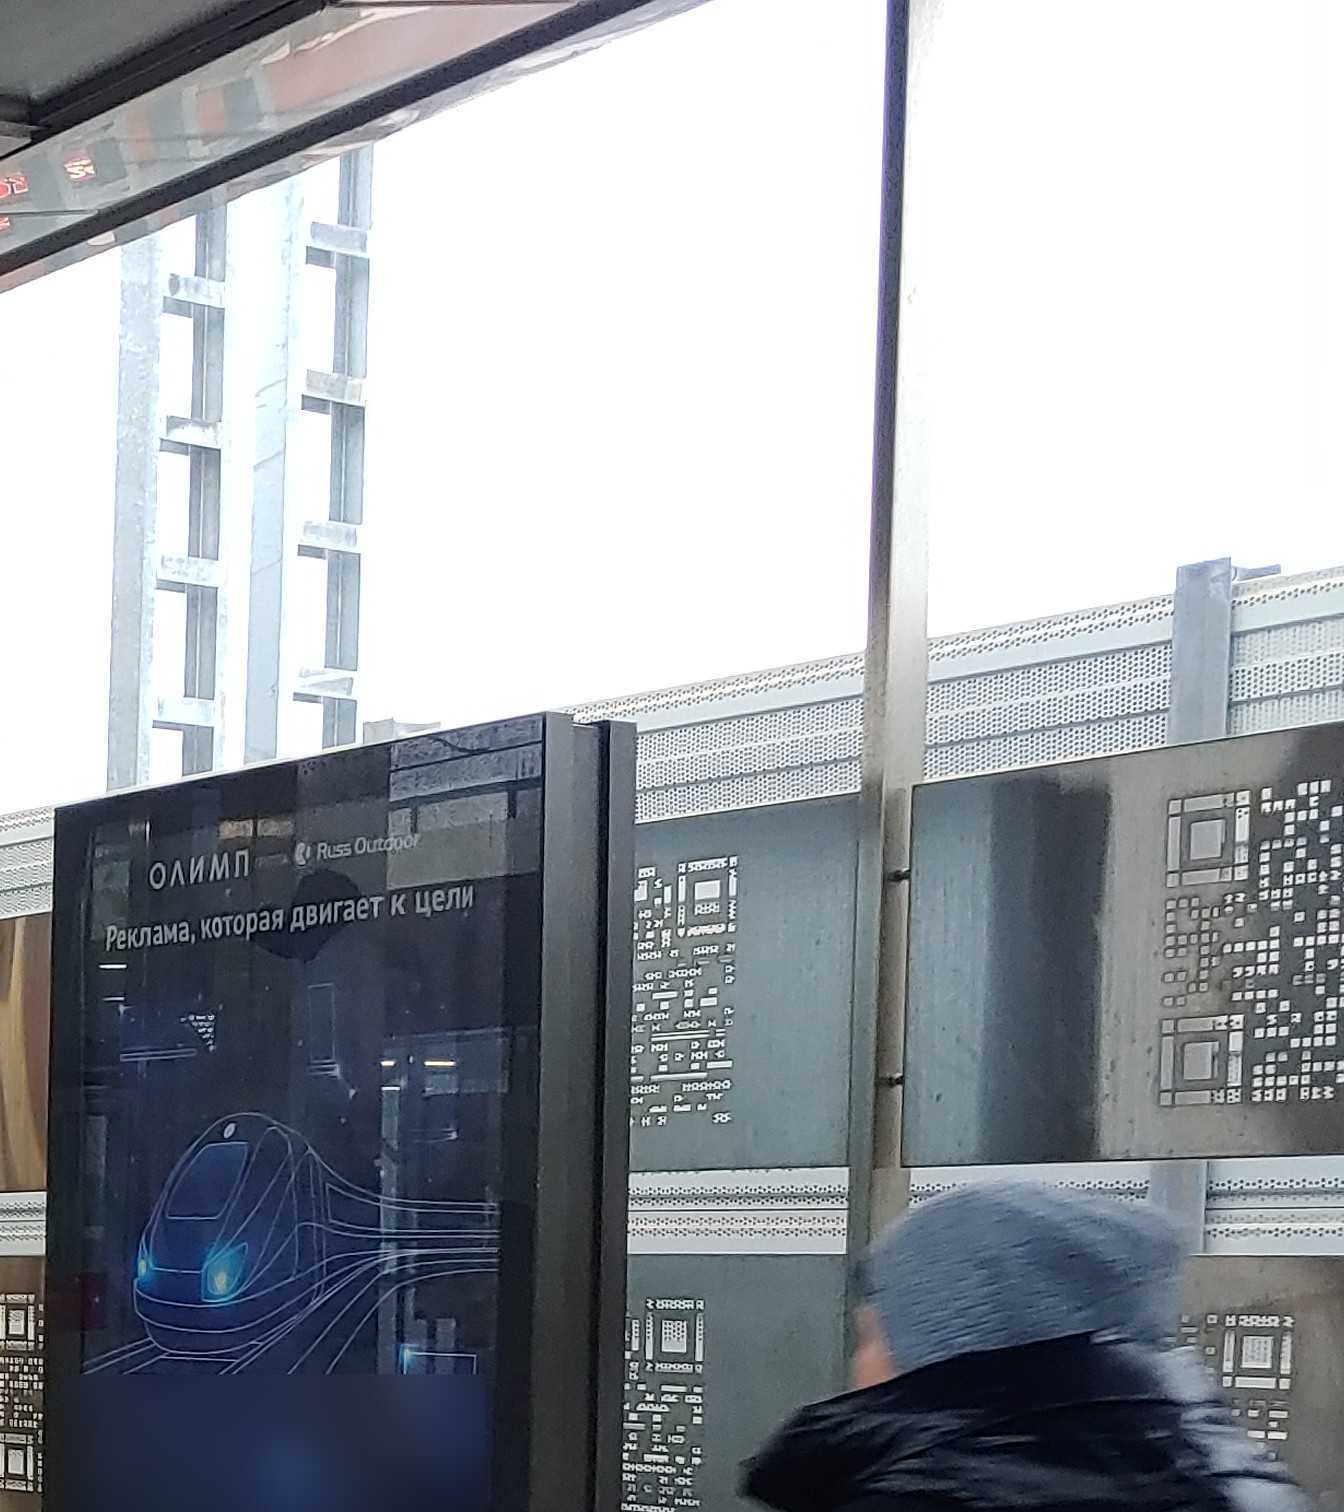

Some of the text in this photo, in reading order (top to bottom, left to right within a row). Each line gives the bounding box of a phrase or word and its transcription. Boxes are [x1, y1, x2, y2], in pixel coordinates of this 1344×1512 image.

[317, 833, 420, 860] Russ Outdoor
[148, 848, 250, 891] ОЛИМП
[106, 885, 474, 951] Реклама, которая двигает к цели
